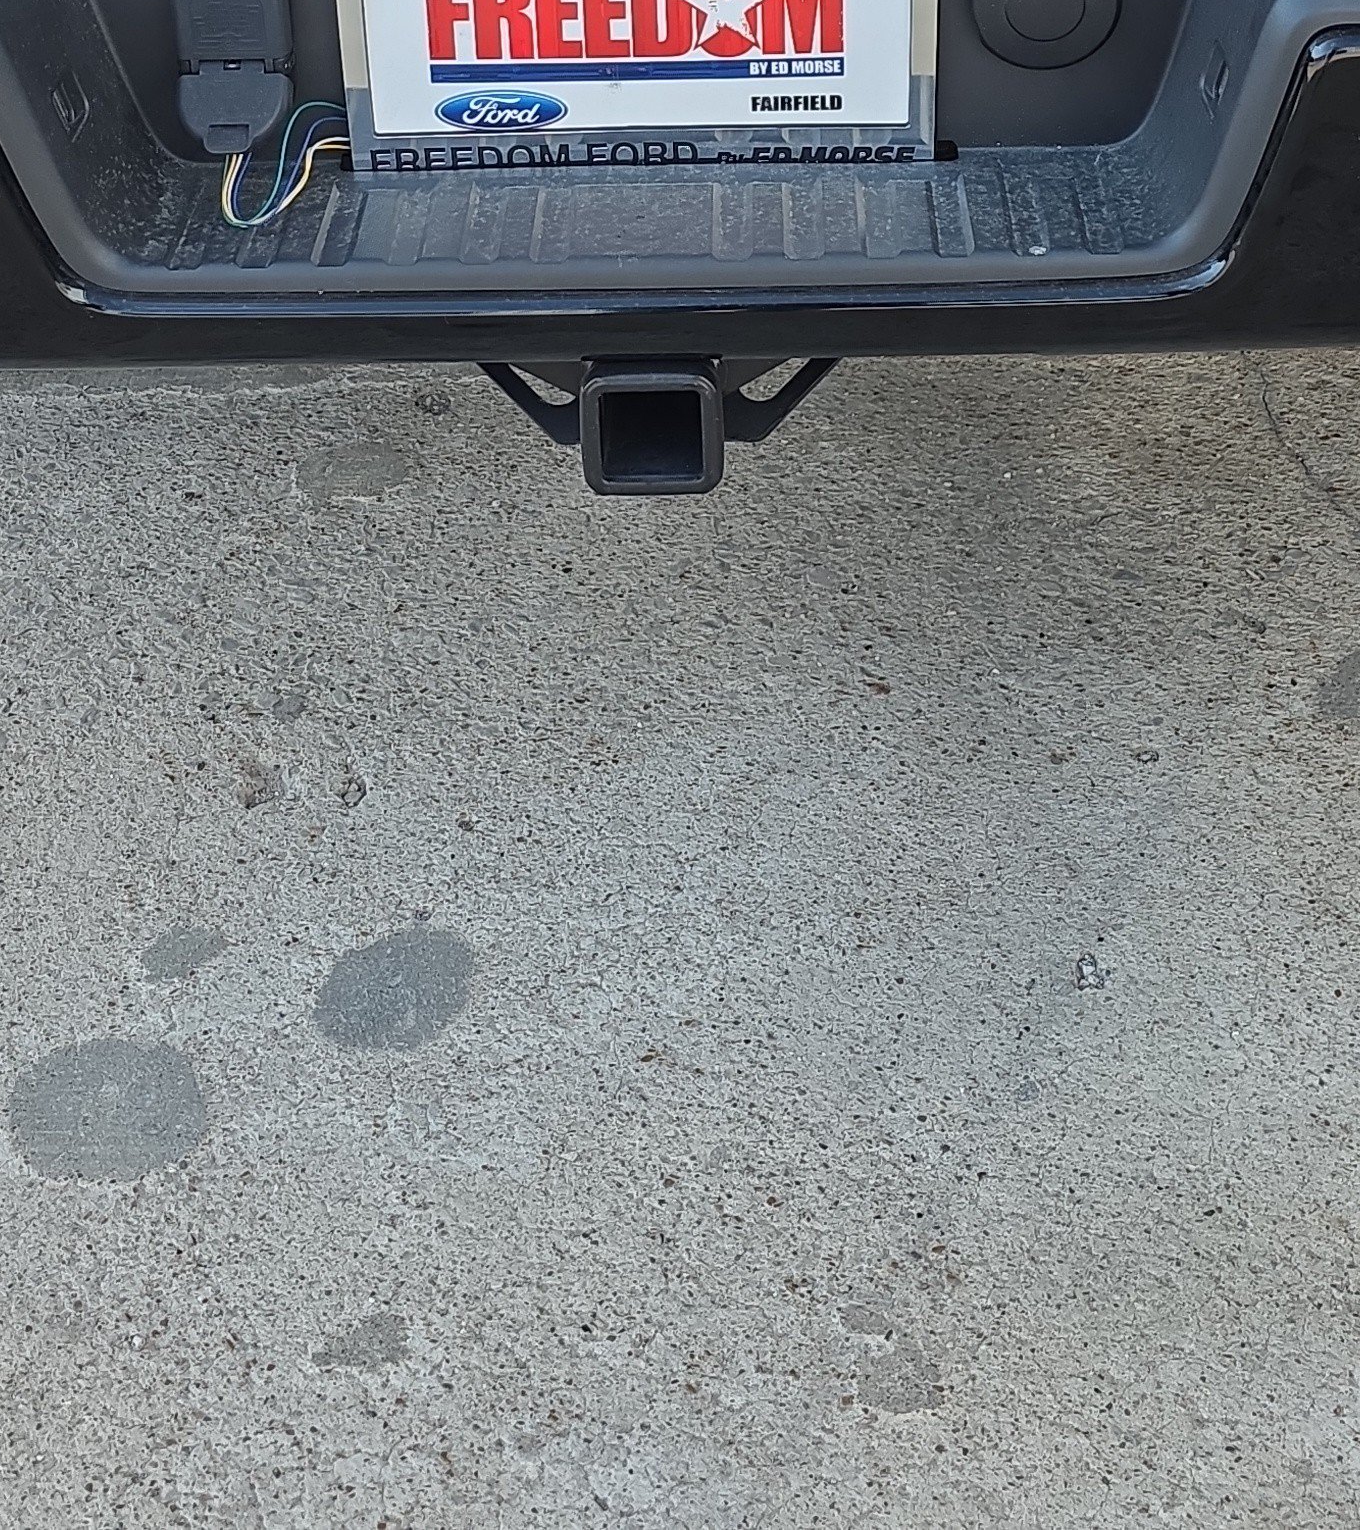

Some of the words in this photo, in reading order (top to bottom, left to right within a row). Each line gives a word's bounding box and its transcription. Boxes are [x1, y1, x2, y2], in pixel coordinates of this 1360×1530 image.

[749, 62, 768, 75] BY
[771, 61, 789, 74] ED
[791, 60, 841, 74] MORSE
[462, 96, 542, 124] Ford
[751, 95, 843, 112] FAIRFIELD
[370, 144, 570, 170] FREEDOM
[586, 141, 698, 166] FORD
